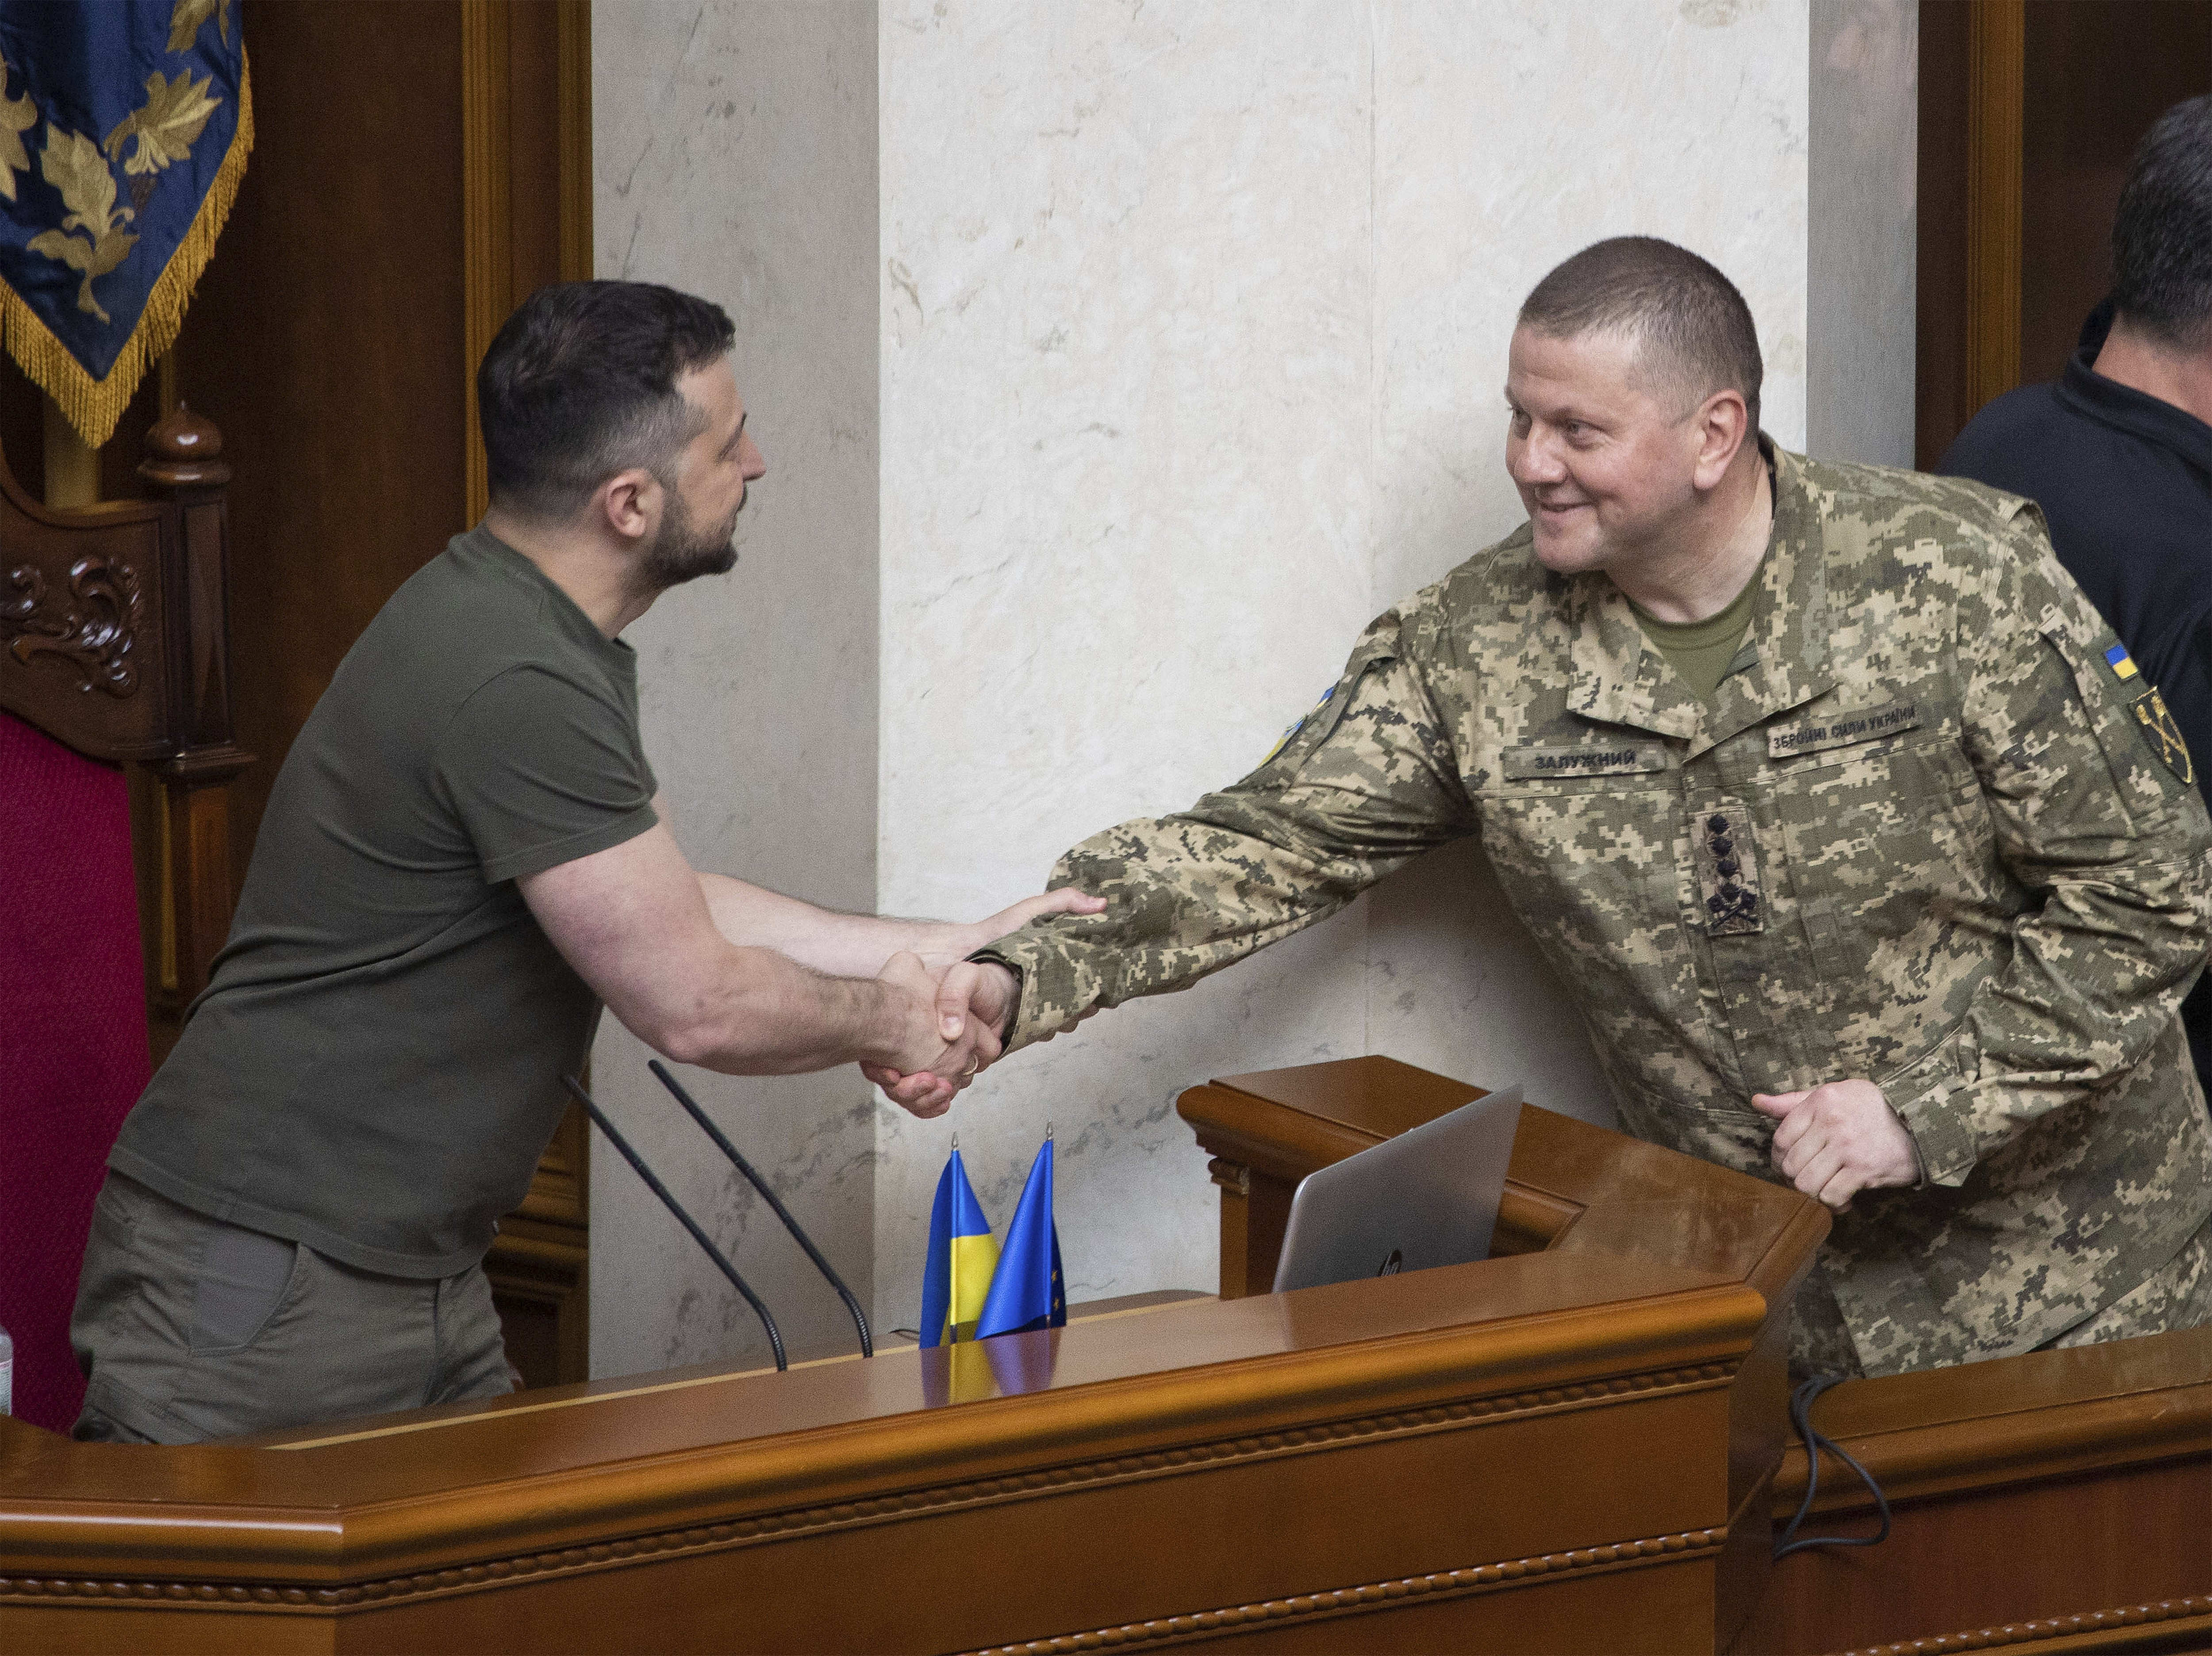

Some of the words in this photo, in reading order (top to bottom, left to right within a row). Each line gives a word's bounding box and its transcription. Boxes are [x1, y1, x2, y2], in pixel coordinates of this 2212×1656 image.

[1774, 728, 1826, 749] ЗБРОЙНІ
[1832, 720, 1866, 738] СИЛИ
[1869, 705, 1915, 730] УКРАЇНИ
[1535, 750, 1636, 769] ЗАЛУЖНИЙ
